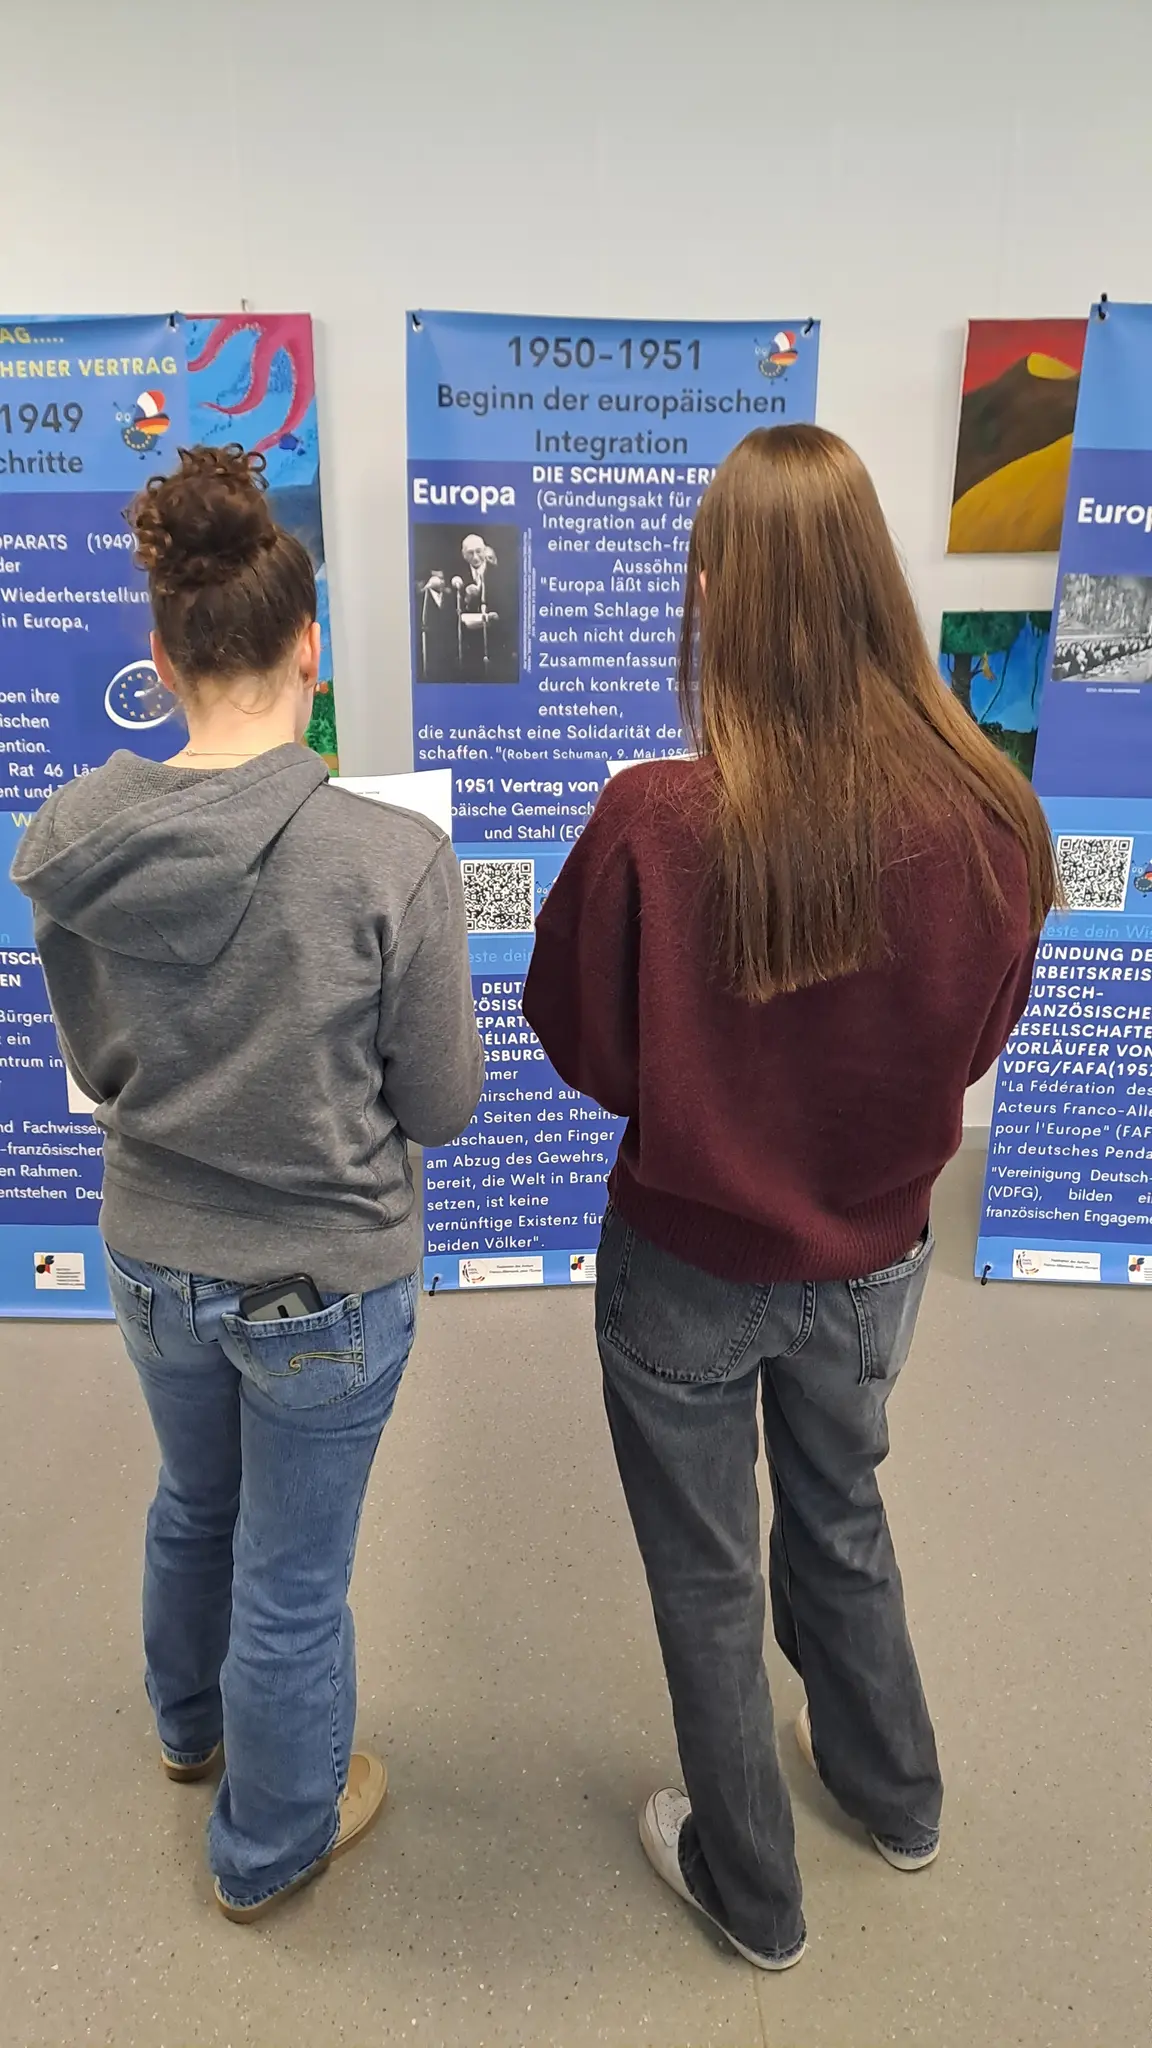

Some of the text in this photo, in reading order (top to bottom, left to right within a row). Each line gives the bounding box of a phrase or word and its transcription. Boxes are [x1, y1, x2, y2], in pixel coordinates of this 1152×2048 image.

[507, 336, 702, 371] 1950-1951
[78, 356, 178, 377] VERTRAG
[437, 384, 787, 420] Beginn der europäischen
[0, 402, 83, 434] 1949
[535, 429, 689, 461] Integration
[532, 466, 563, 484] DIE
[413, 478, 516, 513] Europa
[537, 489, 663, 511] (Gründungsakt
[669, 490, 692, 508] für
[542, 514, 634, 532] Integration
[640, 514, 667, 530] auf
[0, 532, 139, 554] PARATS (1949)
[547, 537, 588, 551] einer
[540, 576, 680, 595] "Europa läßt sich
[539, 604, 588, 618] einem
[593, 602, 659, 621] Schlage
[2, 613, 90, 632] in Europa,
[539, 626, 676, 643] auch nicht durch
[539, 652, 681, 668] Zusammenfassun
[539, 677, 585, 692] durch
[590, 676, 660, 692] konkrete
[31, 689, 60, 704] ihre
[538, 703, 624, 718] entstehen,
[418, 724, 683, 740] die zunächst eine Solidarität der
[553, 748, 613, 761] Schuman,
[617, 748, 629, 759] 9.
[633, 748, 656, 759] Mai
[8, 762, 34, 777] Rat
[44, 763, 63, 777] 46
[24, 783, 53, 799] und
[455, 778, 495, 793] 1951
[501, 778, 563, 797] Vertrag
[568, 780, 598, 793] von
[484, 825, 513, 839] und
[517, 825, 555, 839] Stahl
[1085, 924, 1119, 938] dein
[1032, 965, 1152, 982] RBEITSKREIS
[482, 981, 526, 994] DEUT
[7, 1032, 31, 1045] ein
[1005, 1039, 1110, 1057] VORLÄUFER
[49, 1055, 64, 1068] in
[1001, 1080, 1024, 1093] "La
[1030, 1080, 1115, 1096] Fédération
[997, 1101, 1057, 1114] Acteurs
[483, 1111, 531, 1124] Seiten
[537, 1109, 564, 1122] des
[444, 1128, 615, 1147] uschauen, den Finger
[994, 1124, 1030, 1138] pour
[1035, 1121, 1110, 1140] l'Europe"
[993, 1142, 1012, 1155] ihr
[1017, 1142, 1099, 1158] deutsches
[426, 1150, 609, 1170] am Abzug des Gewehrs,
[20, 1164, 82, 1178] Rahmen.
[991, 1166, 1081, 1183] "Vereinigung
[427, 1177, 477, 1190] bereit,
[482, 1174, 505, 1187] die
[511, 1172, 546, 1185] Welt
[551, 1172, 564, 1184] in
[0, 1185, 67, 1199] entstehen
[988, 1185, 1044, 1201] (VDFG),
[1068, 1188, 1113, 1202] bilden
[427, 1193, 549, 1211] setzen, ist keine
[427, 1212, 603, 1232] vernünftige Existenz für
[986, 1205, 1080, 1222] französischen
[428, 1239, 479, 1252] beiden
